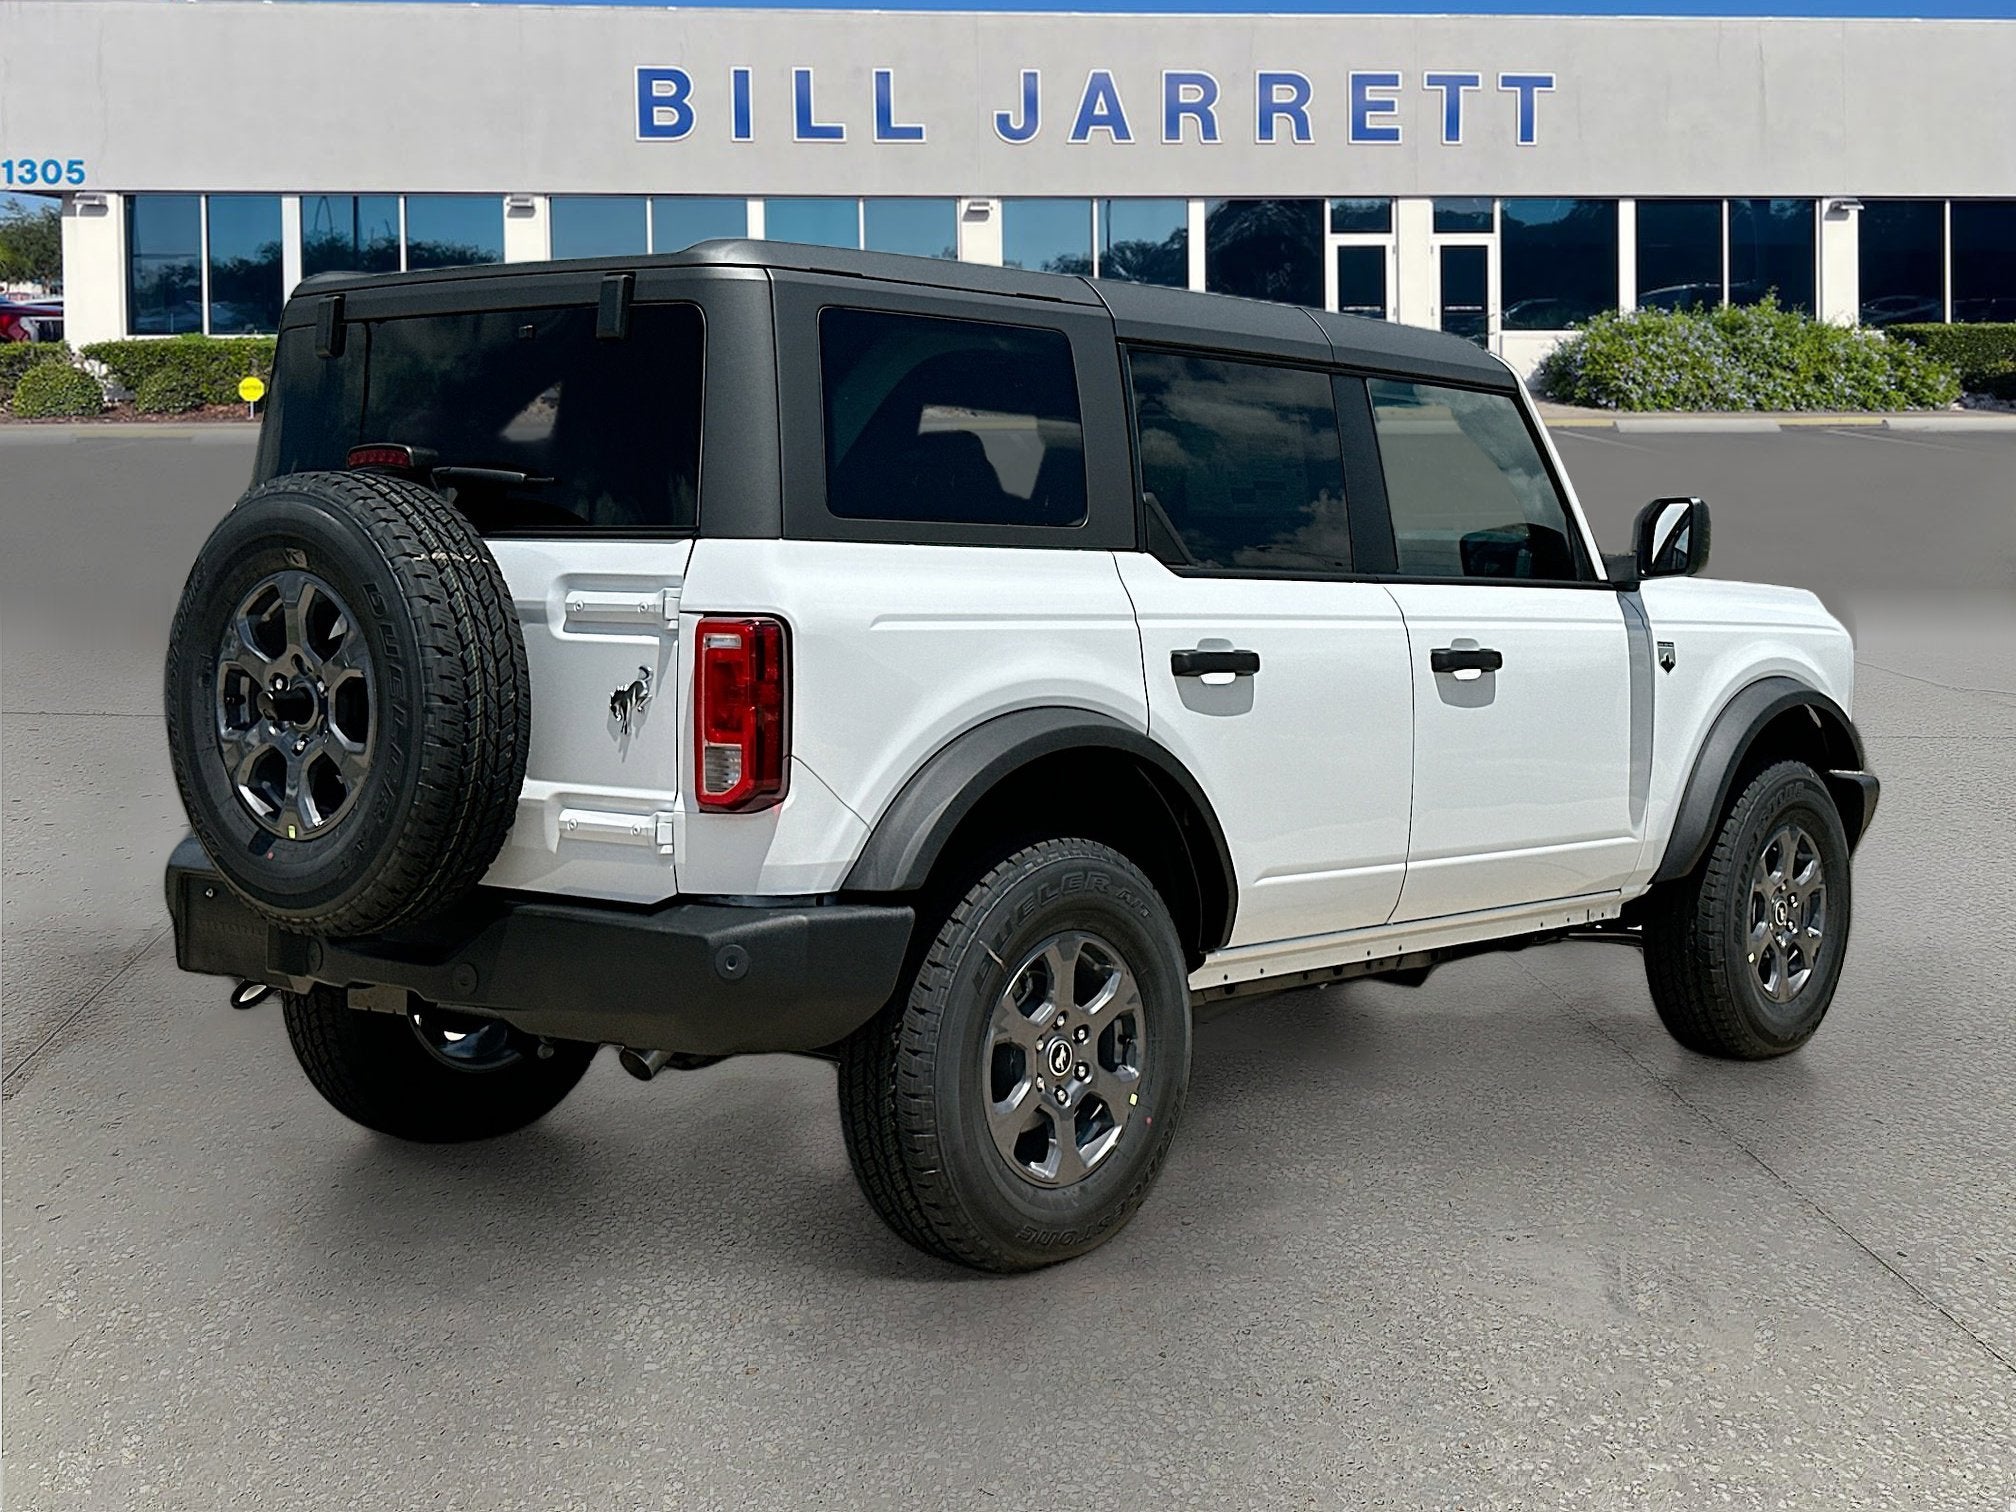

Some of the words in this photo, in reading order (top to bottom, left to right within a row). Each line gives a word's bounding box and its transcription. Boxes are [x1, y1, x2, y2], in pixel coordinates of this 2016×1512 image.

[634, 66, 926, 143] BILL
[992, 68, 1556, 146] JARRETT
[1, 158, 86, 185] 1305
